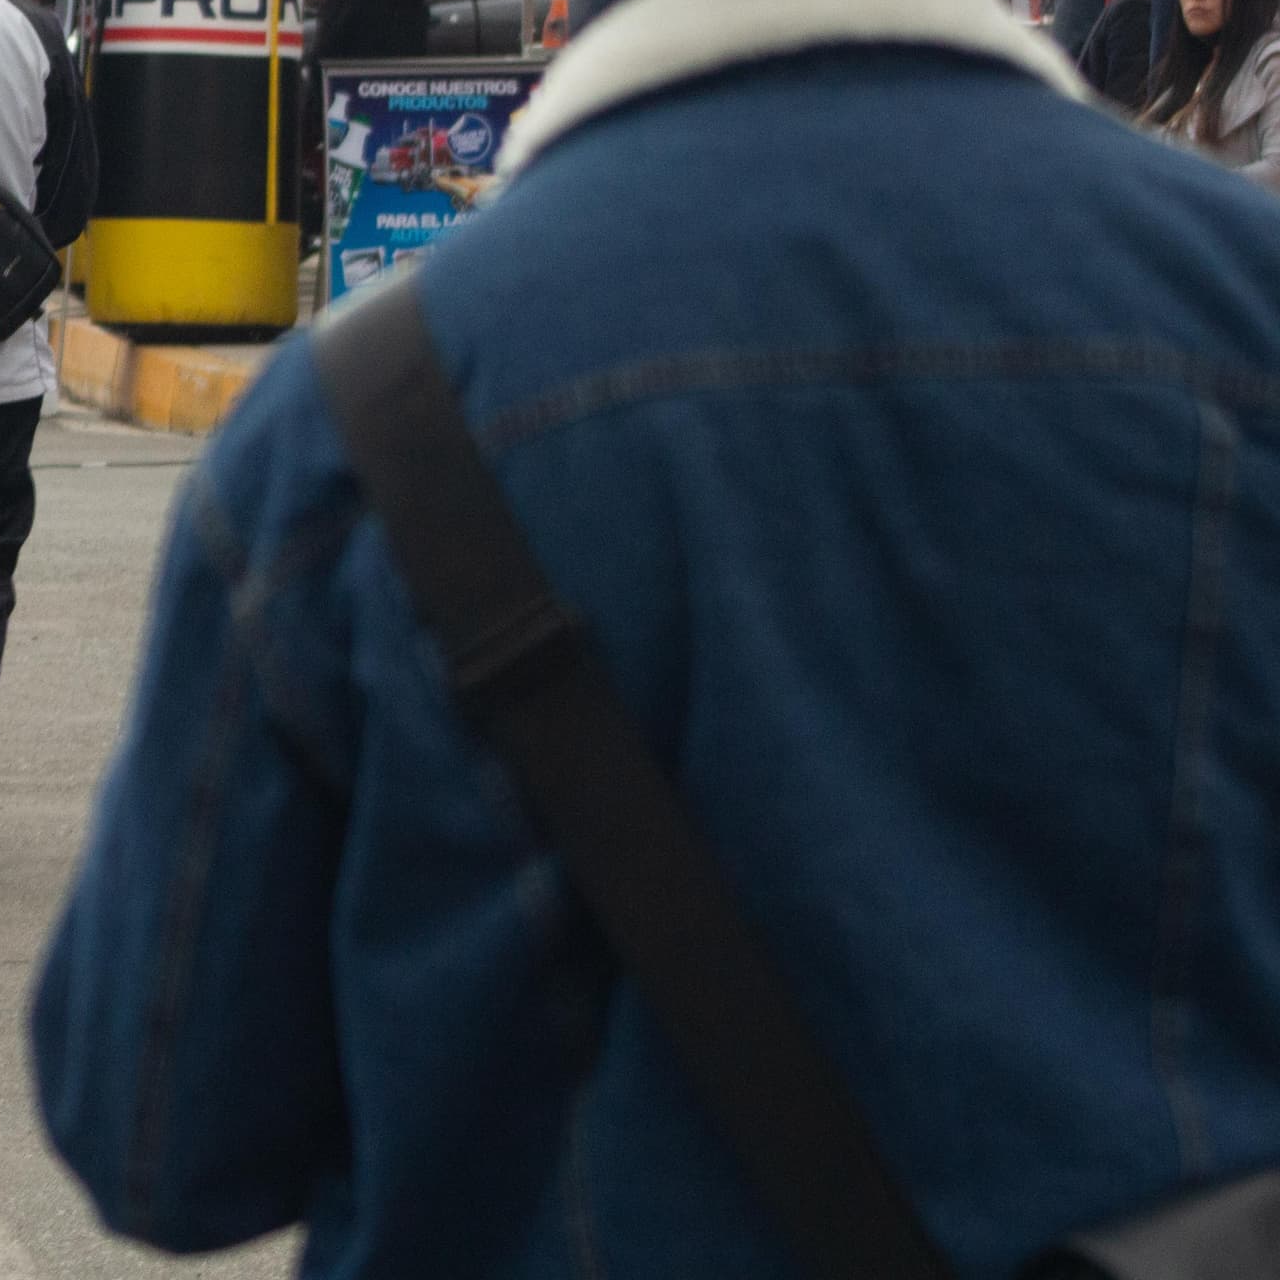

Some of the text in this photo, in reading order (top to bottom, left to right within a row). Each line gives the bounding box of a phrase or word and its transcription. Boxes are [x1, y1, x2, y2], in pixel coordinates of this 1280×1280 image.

[358, 80, 517, 97] CONOCE NUESTROS
[388, 95, 488, 111] PRODUCTOS
[376, 213, 418, 229] PARA
[421, 213, 441, 228] EL
